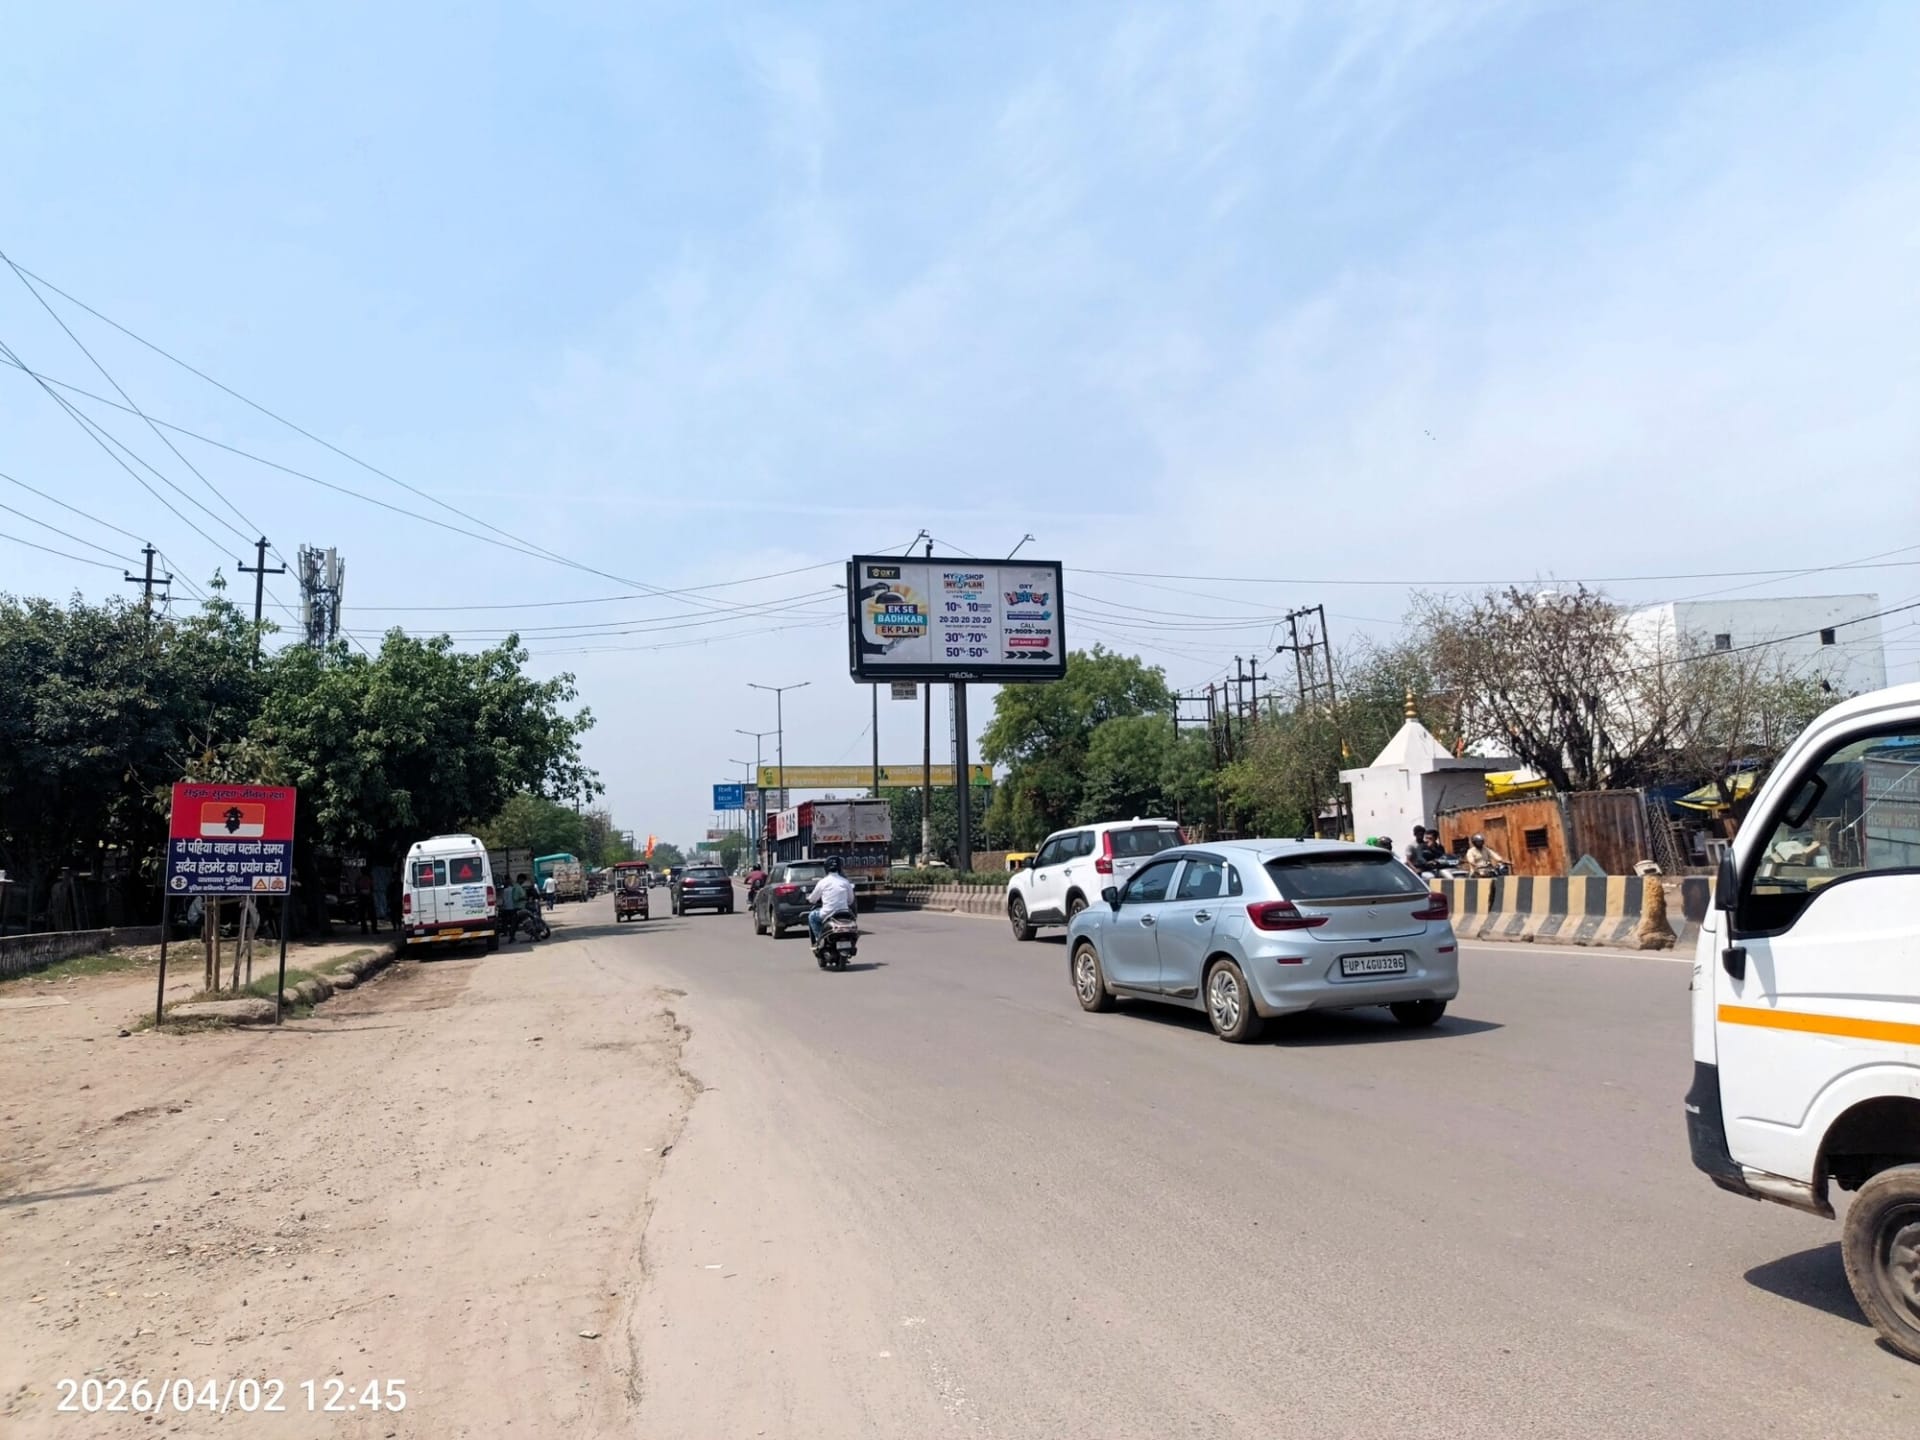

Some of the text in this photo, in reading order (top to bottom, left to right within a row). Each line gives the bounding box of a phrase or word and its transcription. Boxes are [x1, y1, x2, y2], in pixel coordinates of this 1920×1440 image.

[888, 605, 900, 613] EK
[877, 614, 924, 624] BADHKAR
[971, 616, 981, 624] 20
[982, 616, 992, 624] 20
[896, 626, 920, 634] PLAN
[176, 838, 285, 855] दो पहिया वाहन चलाते समय
[175, 857, 197, 873] सदैव
[197, 857, 226, 874] हेलमेट
[226, 861, 239, 873] का
[240, 858, 264, 875] प्रयोग
[1348, 957, 1405, 972] UP14GU3286
